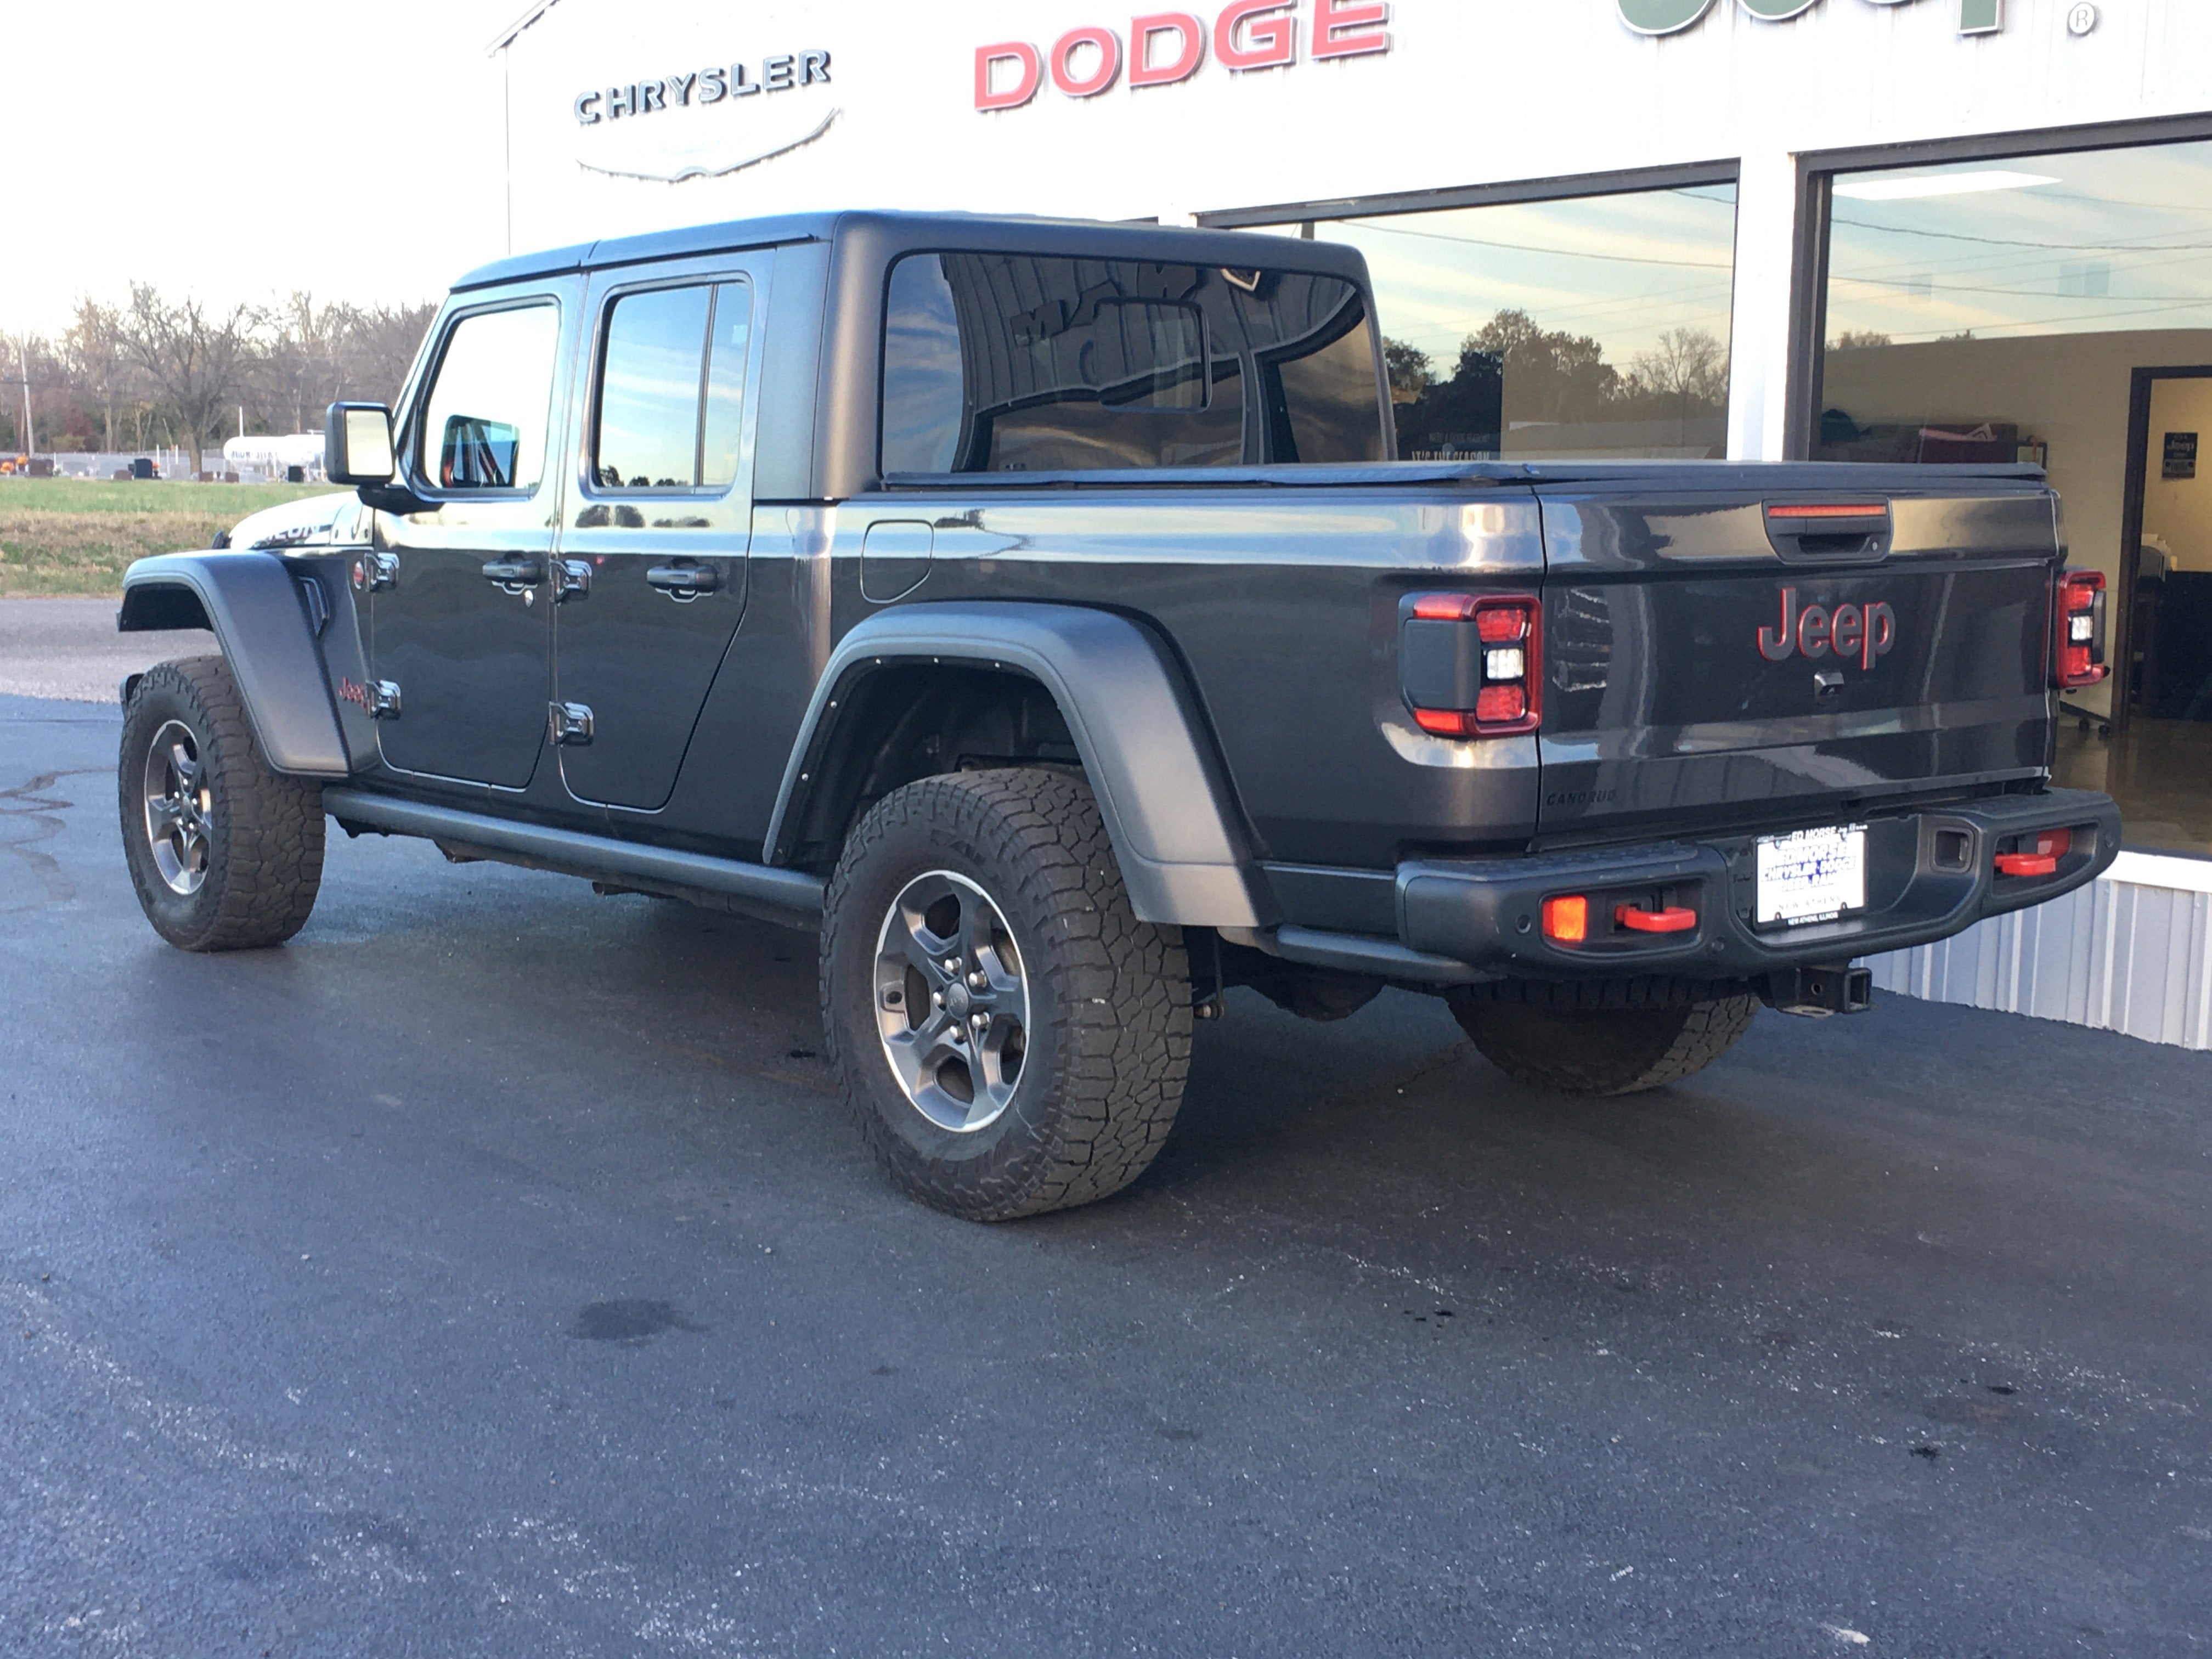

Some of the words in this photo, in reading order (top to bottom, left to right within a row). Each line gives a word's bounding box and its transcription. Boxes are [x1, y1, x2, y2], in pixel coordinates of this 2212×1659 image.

[974, 0, 1390, 112] DODGE
[574, 48, 832, 124] CHRYSLER
[2166, 440, 2194, 452] Jeep
[1758, 587, 1896, 670] Jeep
[338, 676, 367, 709] Jeep
[1805, 826, 1836, 839] MORSE
[1797, 842, 1848, 864] MORSE
[1805, 895, 1841, 907] ATHENS
